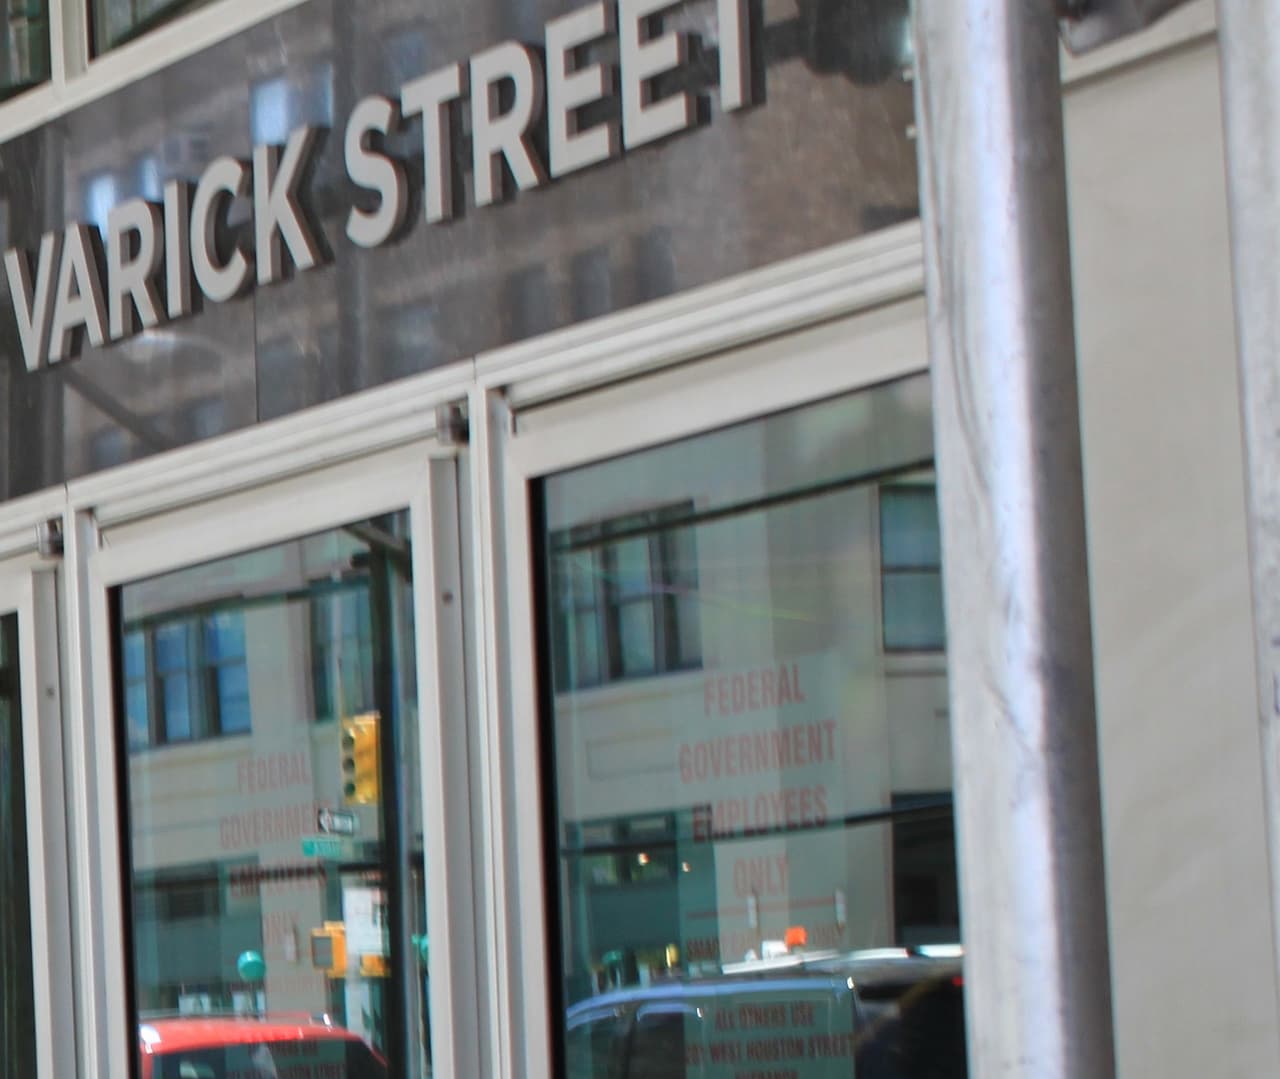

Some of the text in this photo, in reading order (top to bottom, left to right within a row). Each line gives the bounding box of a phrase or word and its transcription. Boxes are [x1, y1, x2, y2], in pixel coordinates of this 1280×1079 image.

[4, 127, 324, 373] VARICK
[702, 663, 807, 719] FEDERAL
[678, 719, 837, 785] GOVERNMENT
